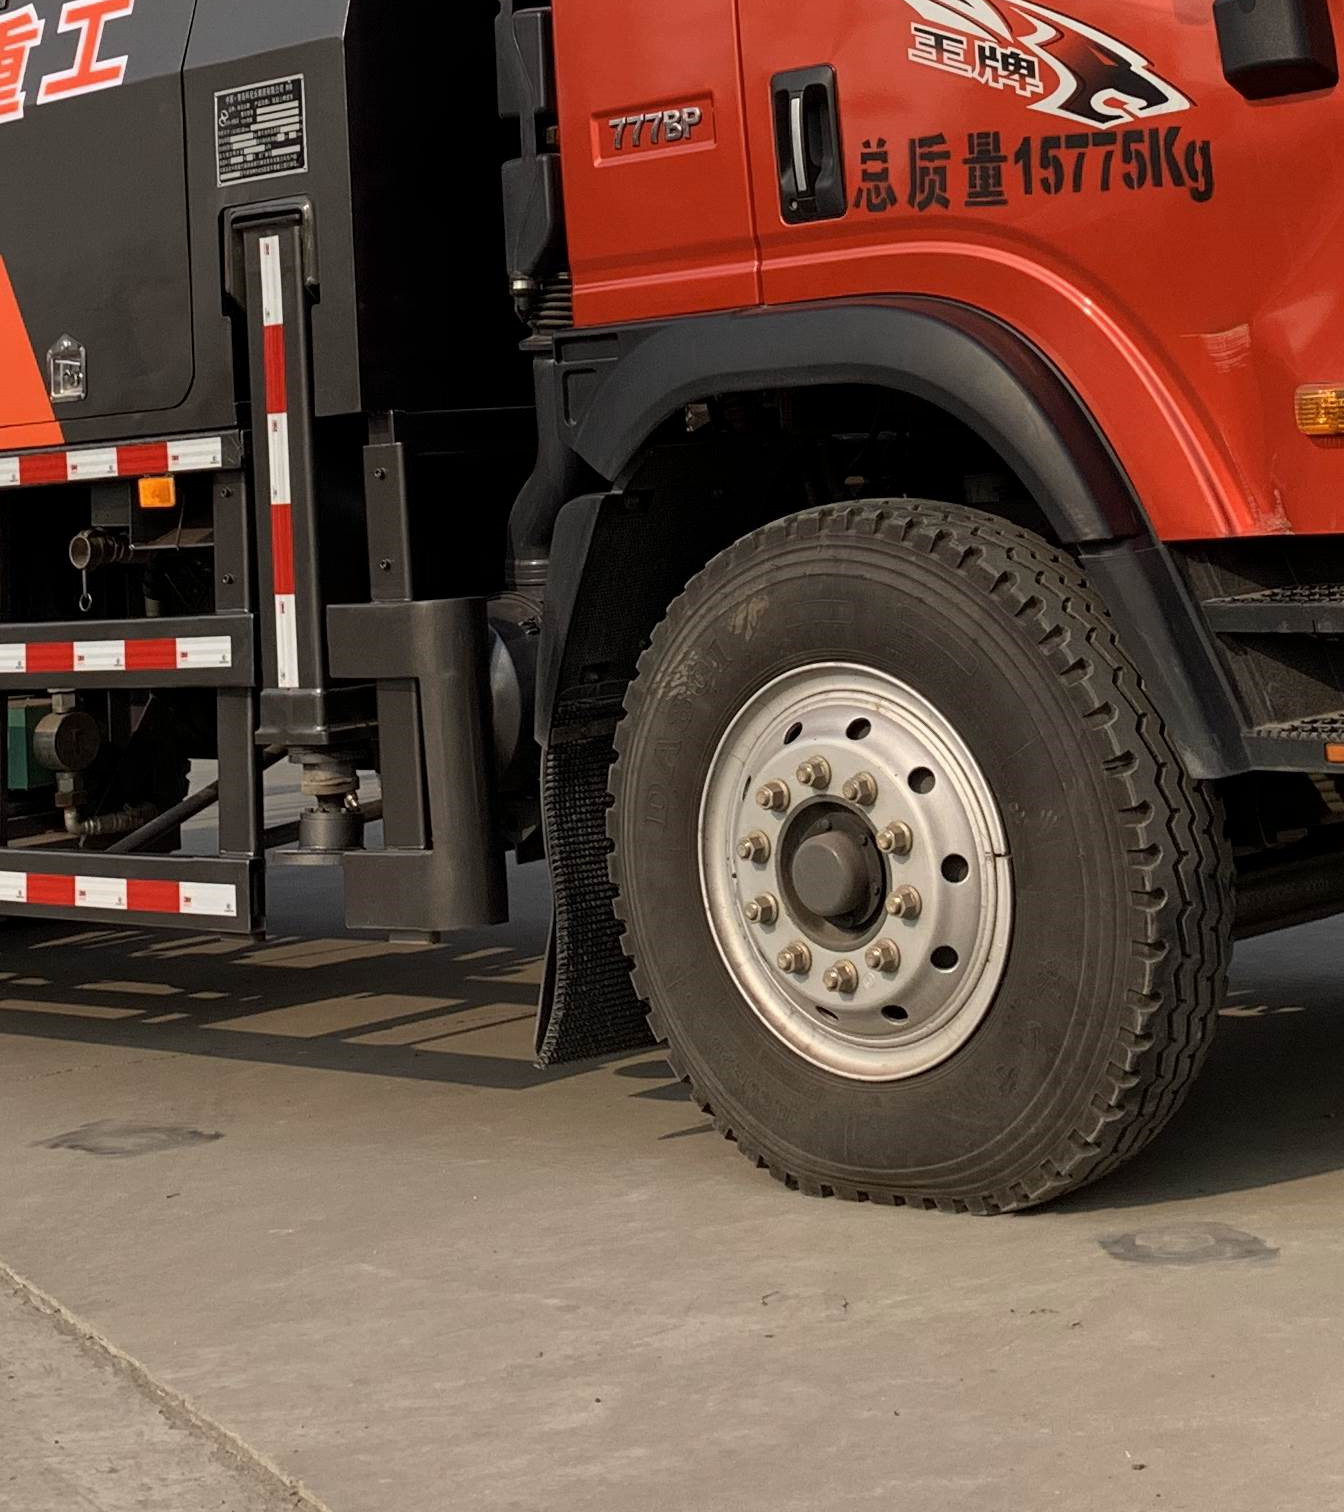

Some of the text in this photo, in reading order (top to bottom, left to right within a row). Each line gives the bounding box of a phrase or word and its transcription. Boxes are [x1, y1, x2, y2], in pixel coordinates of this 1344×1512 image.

[908, 22, 1044, 97] 王牌
[608, 107, 702, 149] 777BP
[853, 126, 1215, 213] 总质量15775Kg
